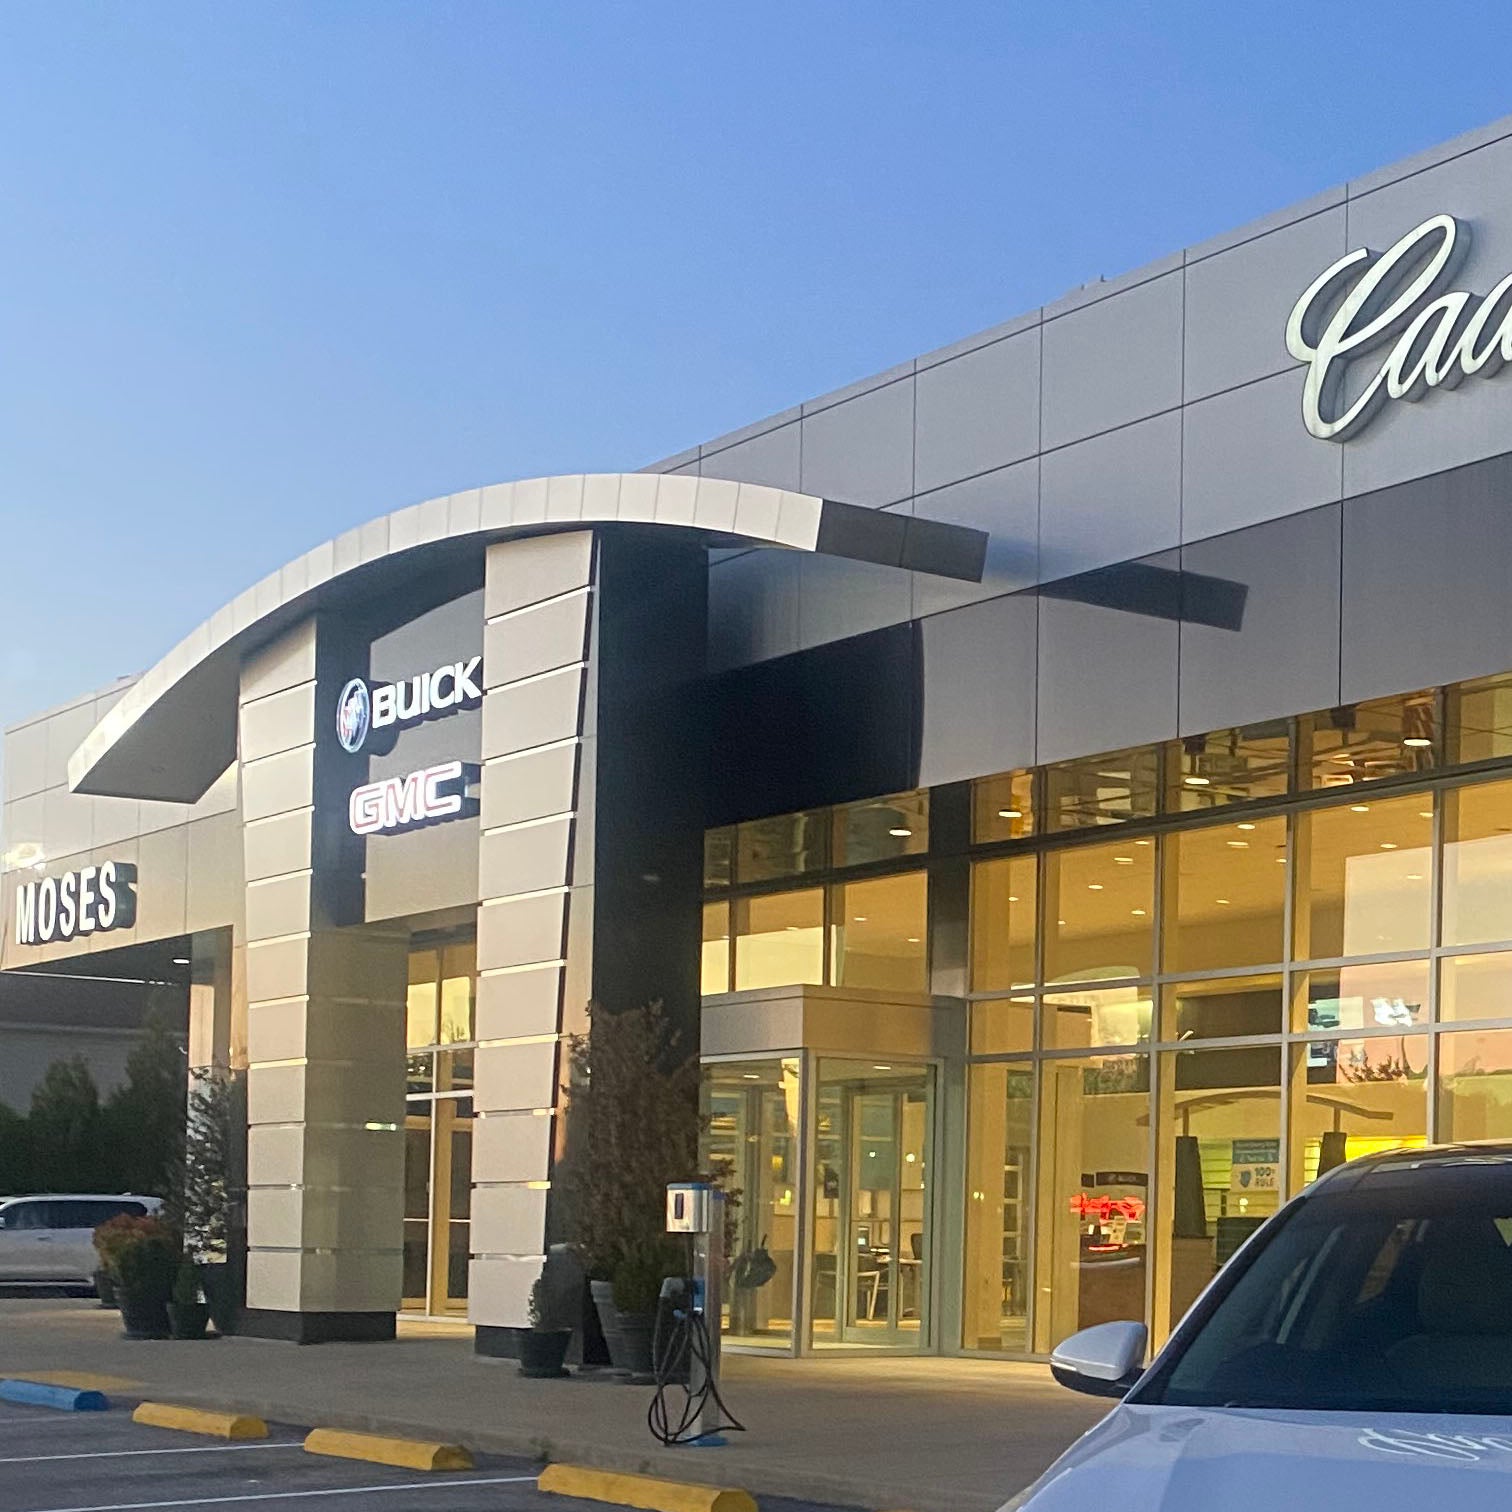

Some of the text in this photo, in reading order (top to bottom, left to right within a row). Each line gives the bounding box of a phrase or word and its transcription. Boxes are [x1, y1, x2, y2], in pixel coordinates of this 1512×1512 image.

[372, 656, 483, 729] BUICK
[350, 760, 462, 835] GMC
[15, 860, 117, 945] MOSES
